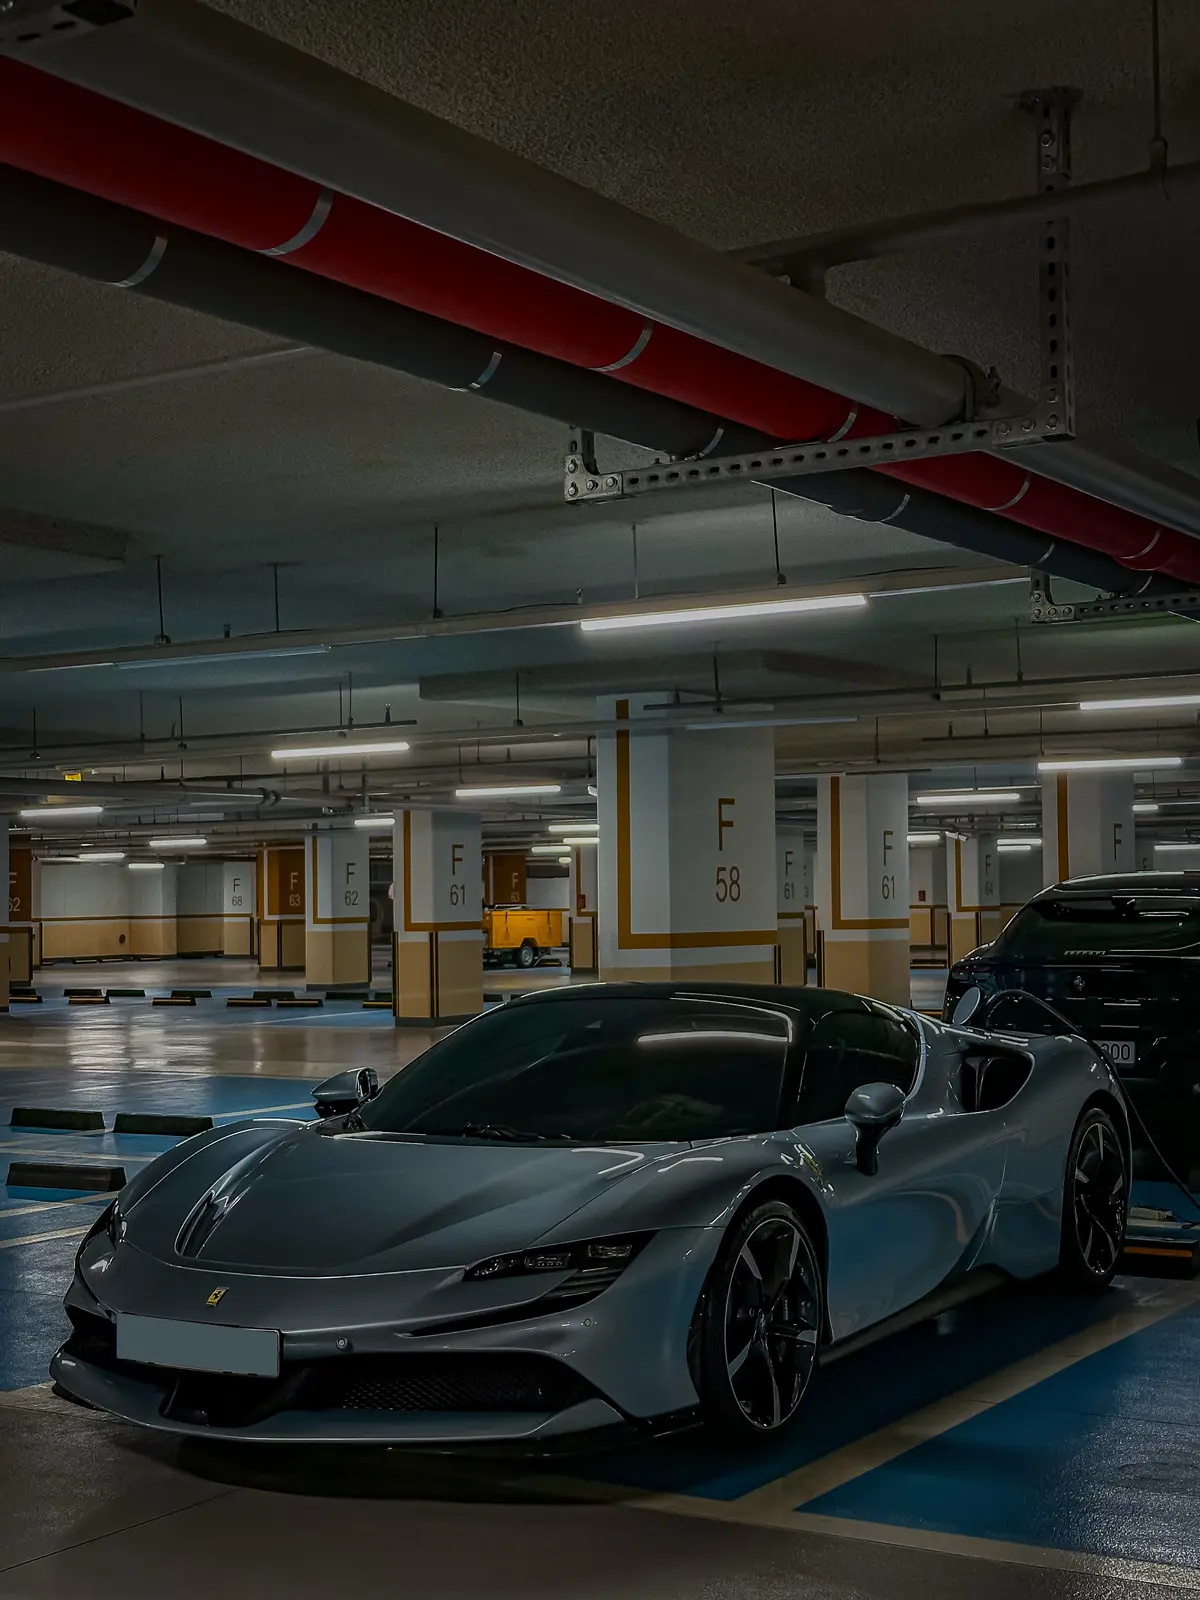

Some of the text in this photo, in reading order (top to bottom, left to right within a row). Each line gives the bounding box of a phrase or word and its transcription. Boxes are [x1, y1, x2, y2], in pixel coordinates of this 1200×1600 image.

[718, 798, 735, 851] F
[883, 830, 894, 866] F
[1113, 823, 1123, 861] F
[451, 844, 464, 876] F
[785, 851, 793, 876] F
[985, 854, 991, 876] F
[290, 872, 299, 891] F
[346, 862, 355, 885] F
[512, 872, 519, 889] F
[716, 866, 741, 902] 58
[233, 878, 241, 893] F
[450, 884, 466, 906] 61
[784, 882, 795, 900] 61
[881, 875, 895, 900] 61
[232, 896, 243, 907] 68
[289, 894, 301, 907] 63
[344, 890, 359, 906] 62
